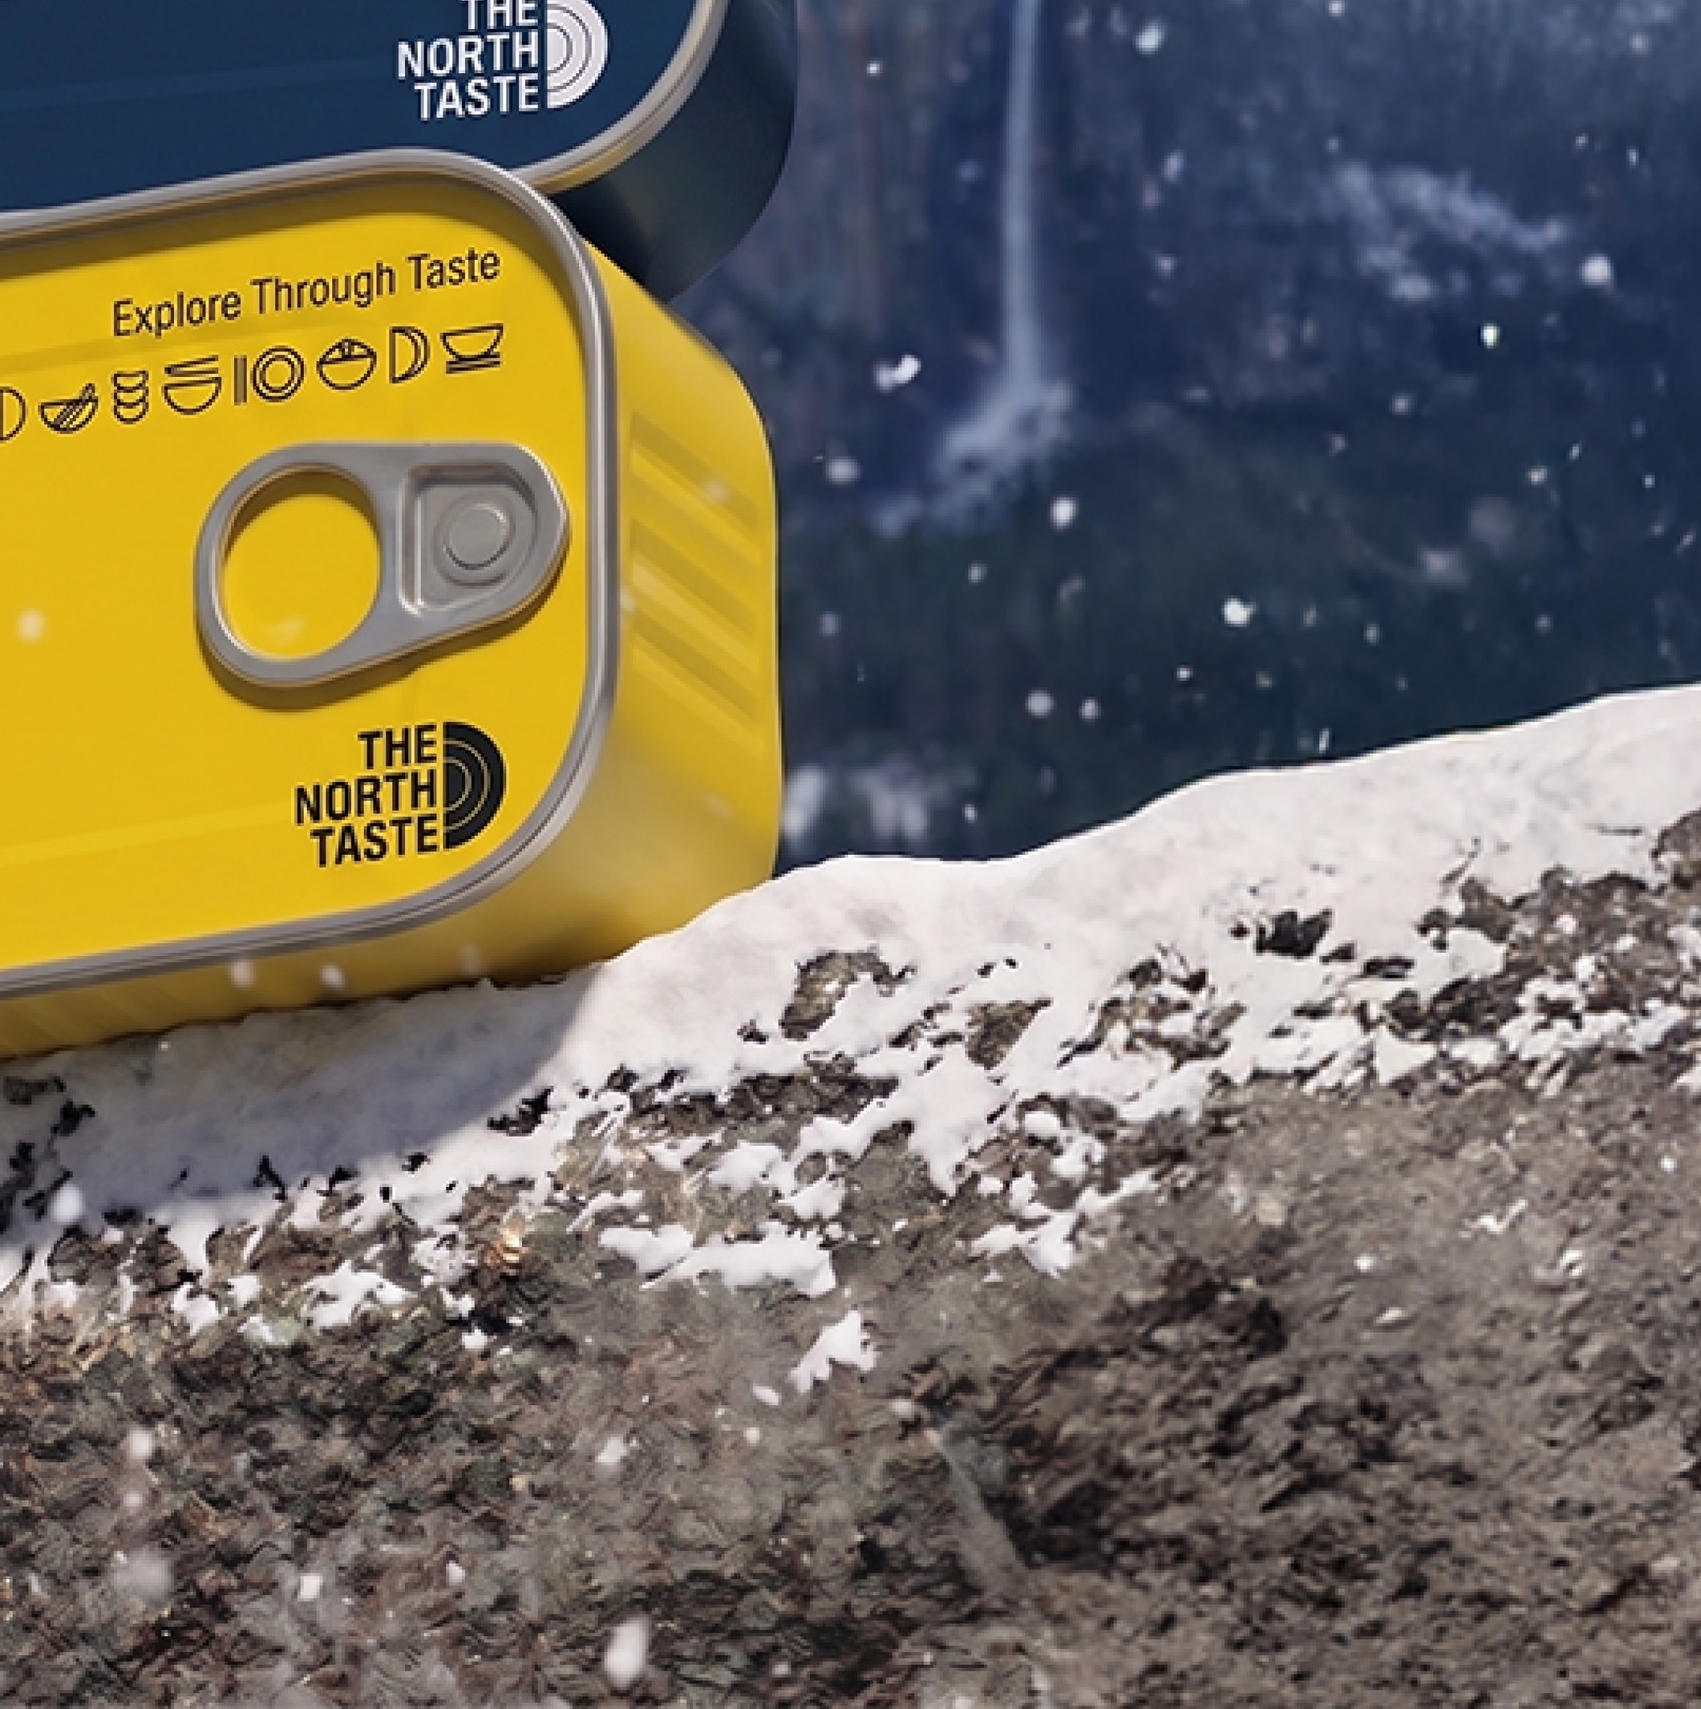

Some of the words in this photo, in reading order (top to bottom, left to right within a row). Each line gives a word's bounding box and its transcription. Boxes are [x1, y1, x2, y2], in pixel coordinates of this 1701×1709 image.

[398, 29, 538, 79] NORTH
[414, 73, 538, 120] TASTE
[114, 292, 241, 339] Explore
[250, 263, 395, 314] Through
[408, 248, 500, 289] Taste
[358, 722, 437, 769] THE
[296, 769, 436, 826] NORTH
[310, 813, 439, 868] TASTE
